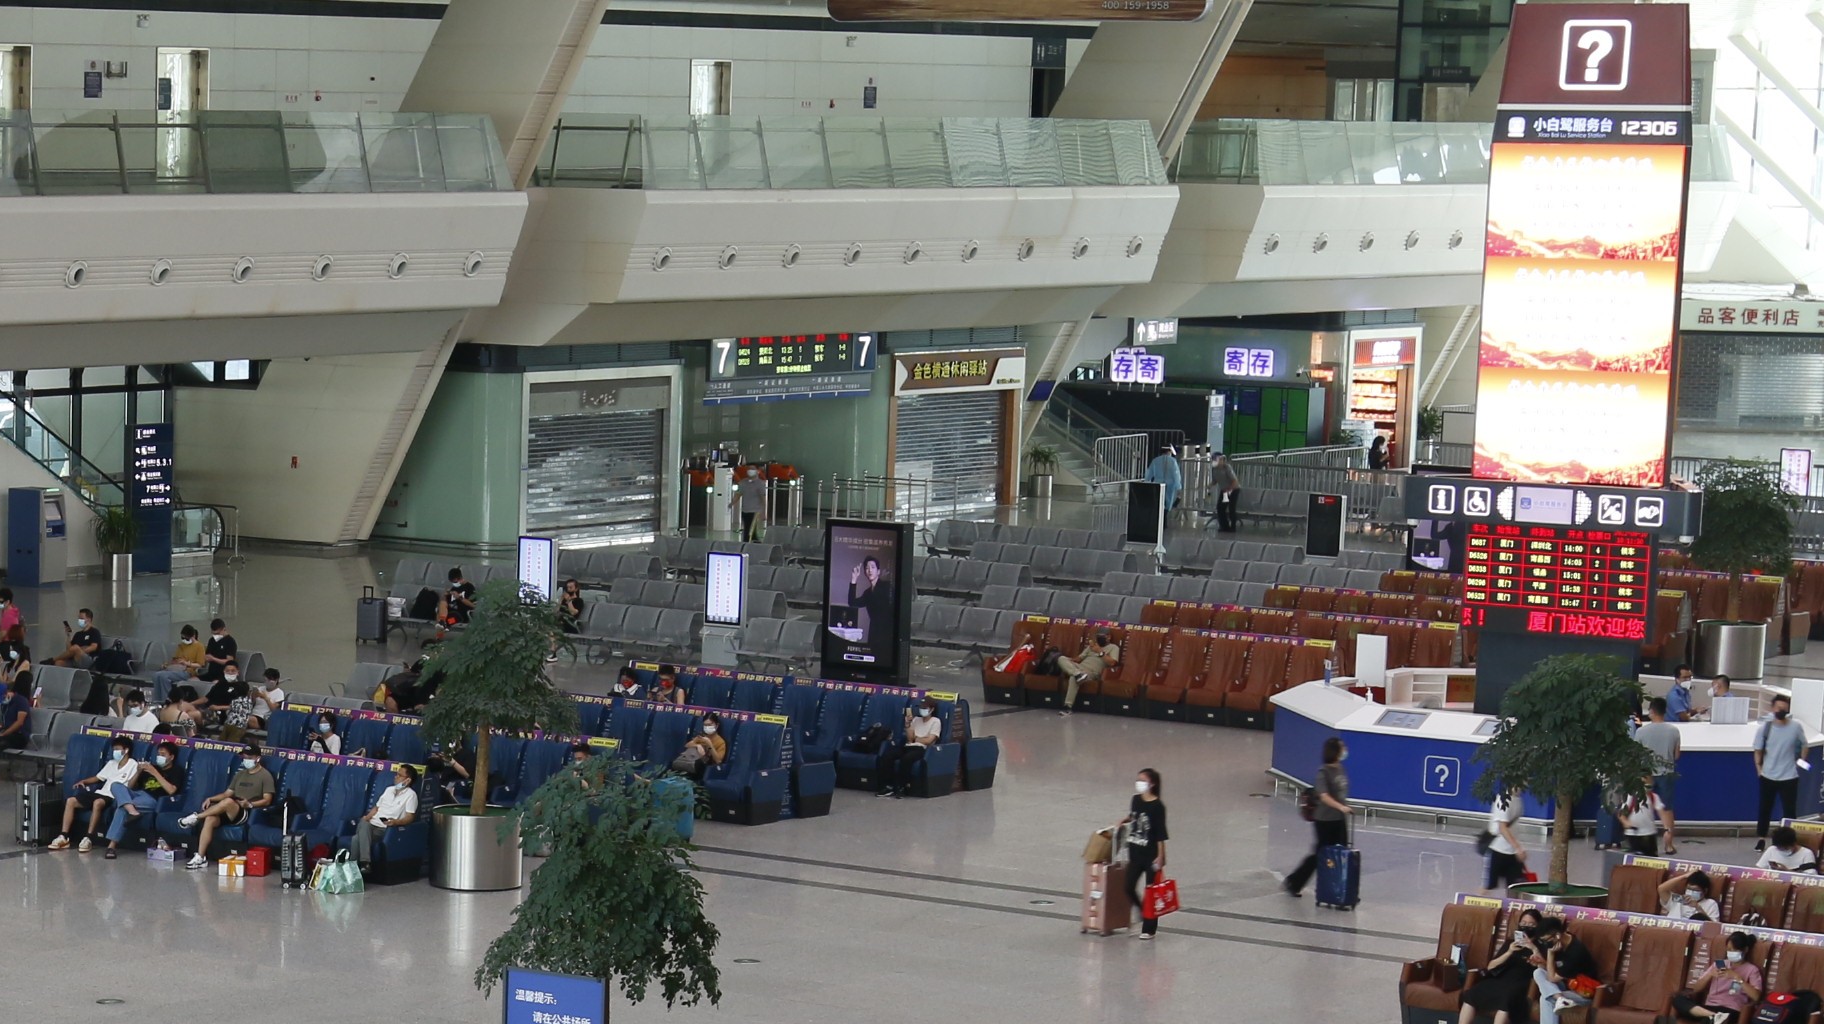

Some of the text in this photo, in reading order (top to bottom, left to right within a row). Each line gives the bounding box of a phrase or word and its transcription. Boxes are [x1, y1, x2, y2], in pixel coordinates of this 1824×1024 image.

[1146, 1, 1169, 9] 1958
[1533, 117, 1613, 133] 小白鹭服务台
[1621, 121, 1677, 136] 12306
[1698, 307, 1800, 326] 品客便利店
[717, 342, 731, 374] 7
[858, 336, 872, 367] 7
[1226, 351, 1271, 375] 寄存
[1528, 611, 1646, 639] 厦门站欢迎您
